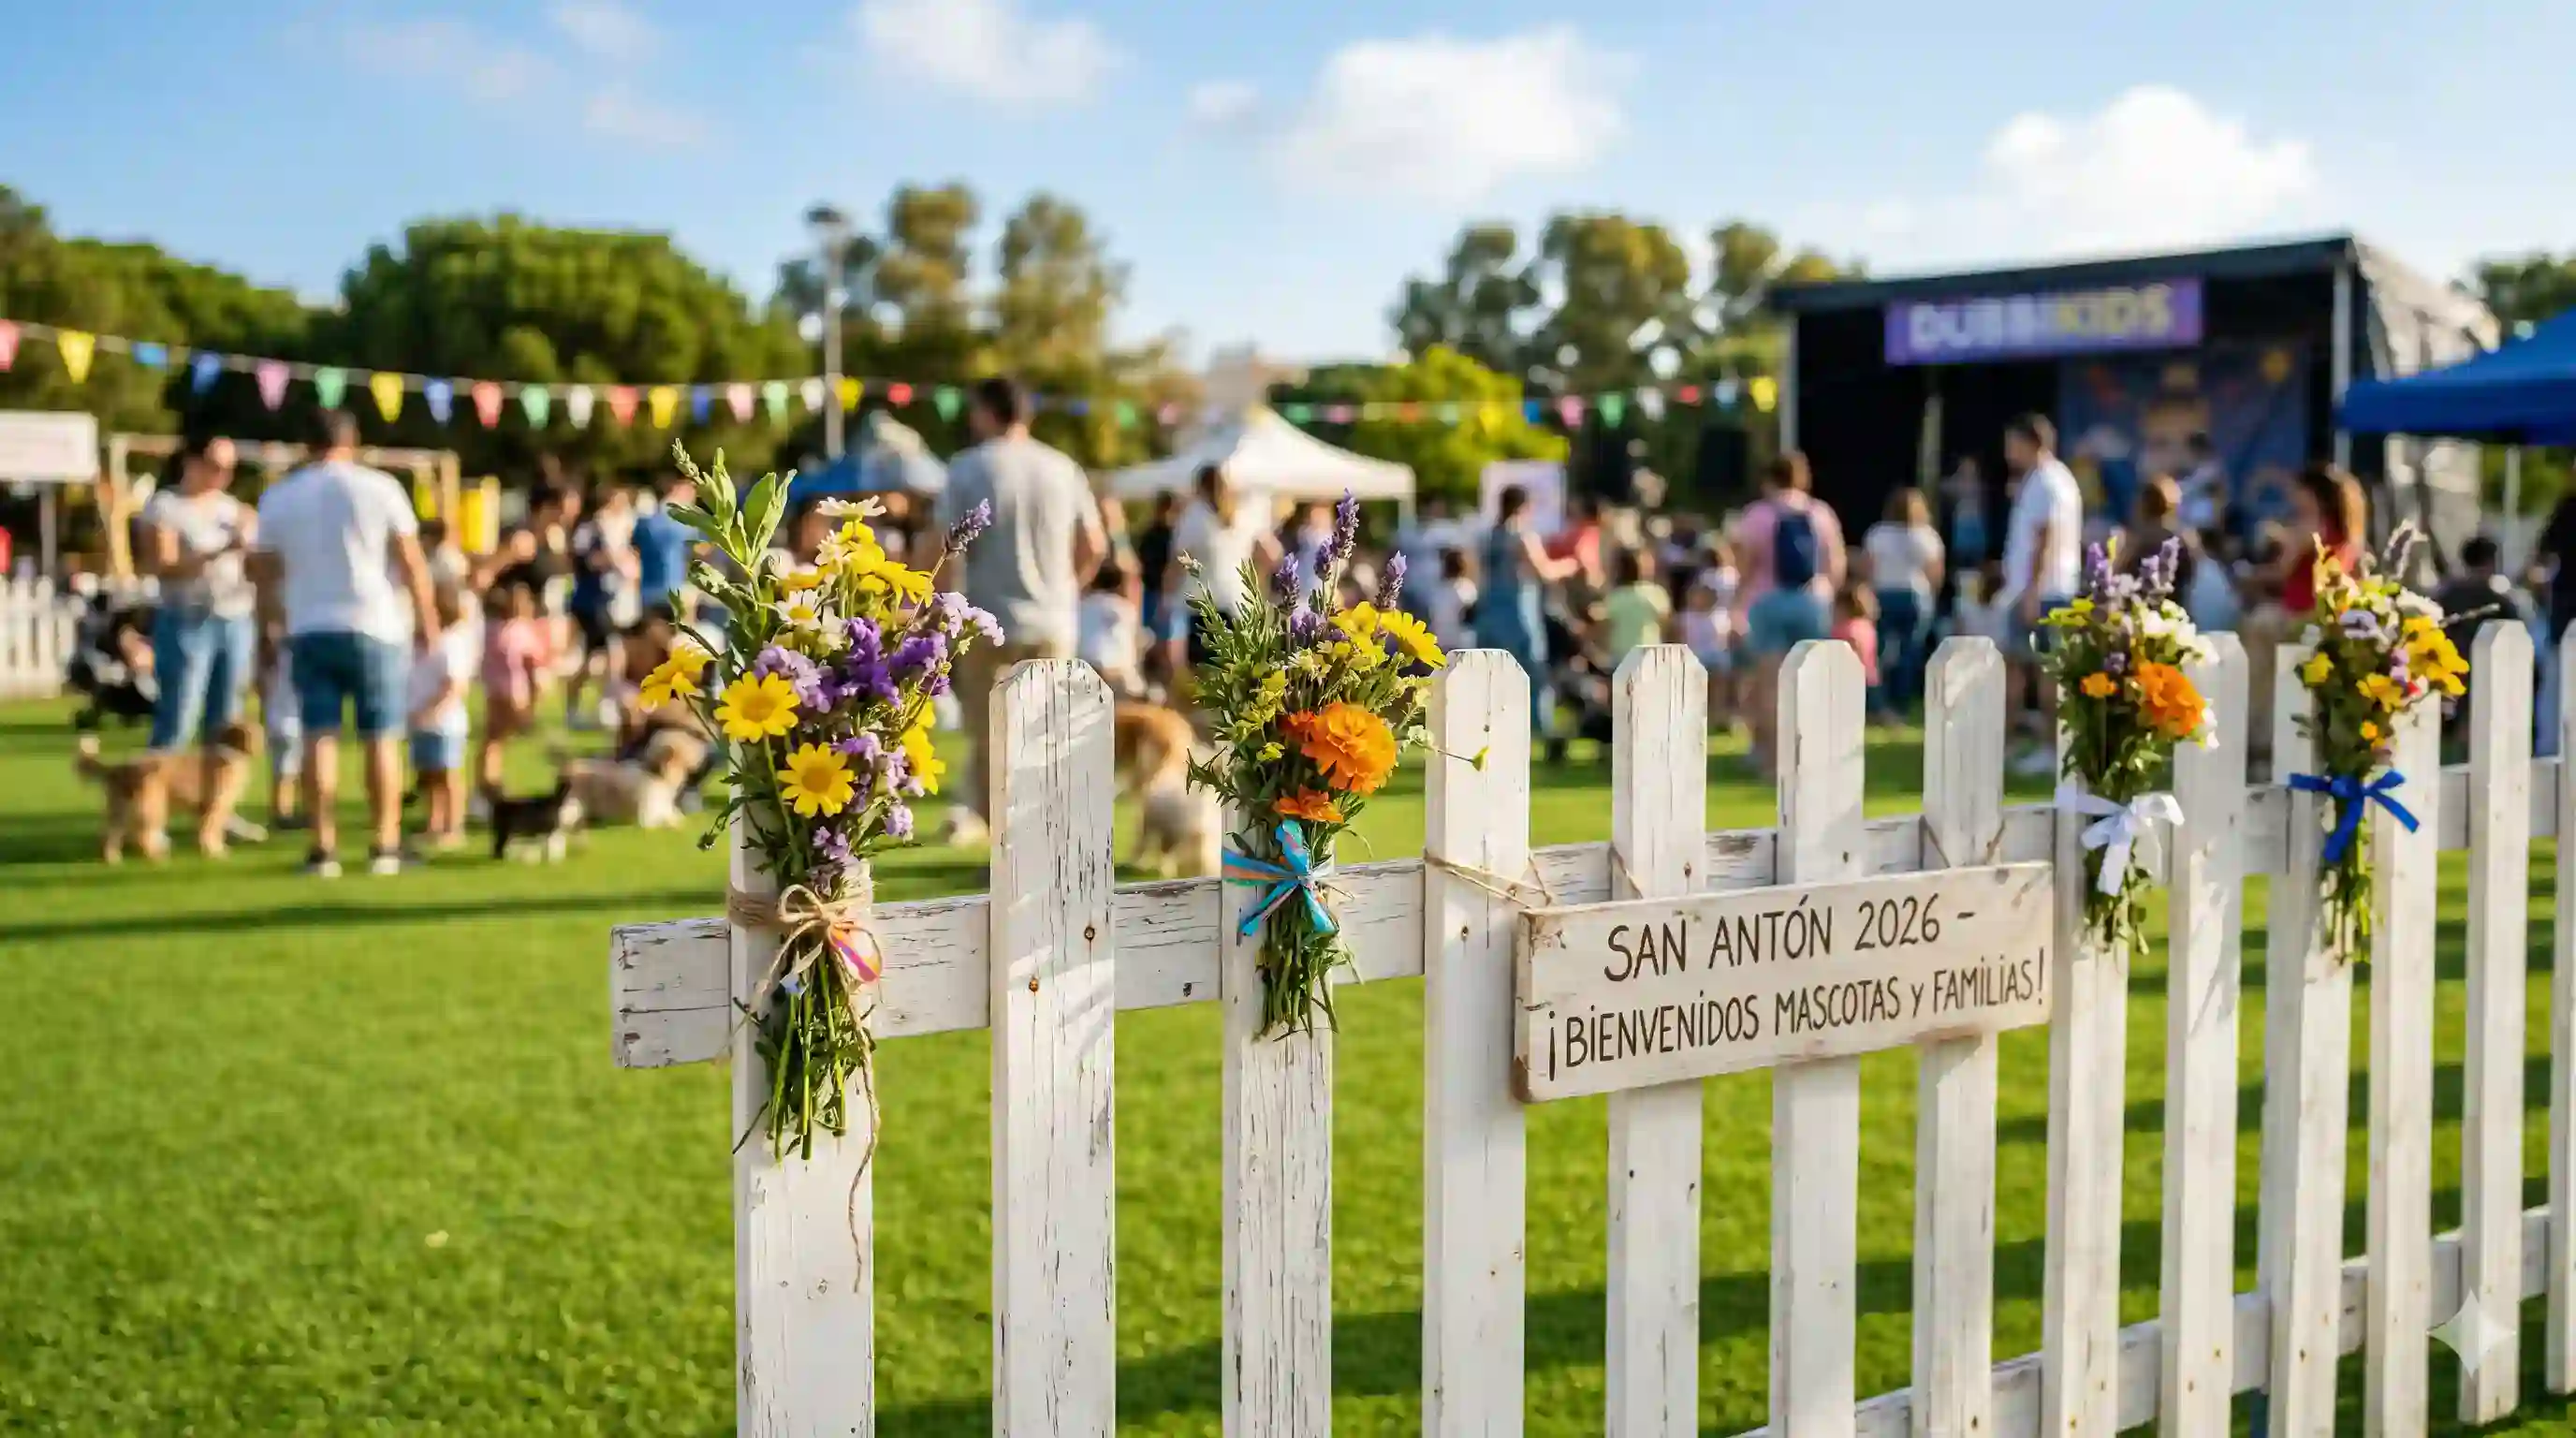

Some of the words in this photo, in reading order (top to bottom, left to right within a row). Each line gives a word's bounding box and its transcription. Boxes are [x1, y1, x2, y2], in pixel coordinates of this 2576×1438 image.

[1603, 918, 1687, 982] SAN
[1707, 894, 1833, 969] ANTÓN
[1854, 893, 1940, 951] 2026
[1775, 976, 1901, 1036] MASCOTAS
